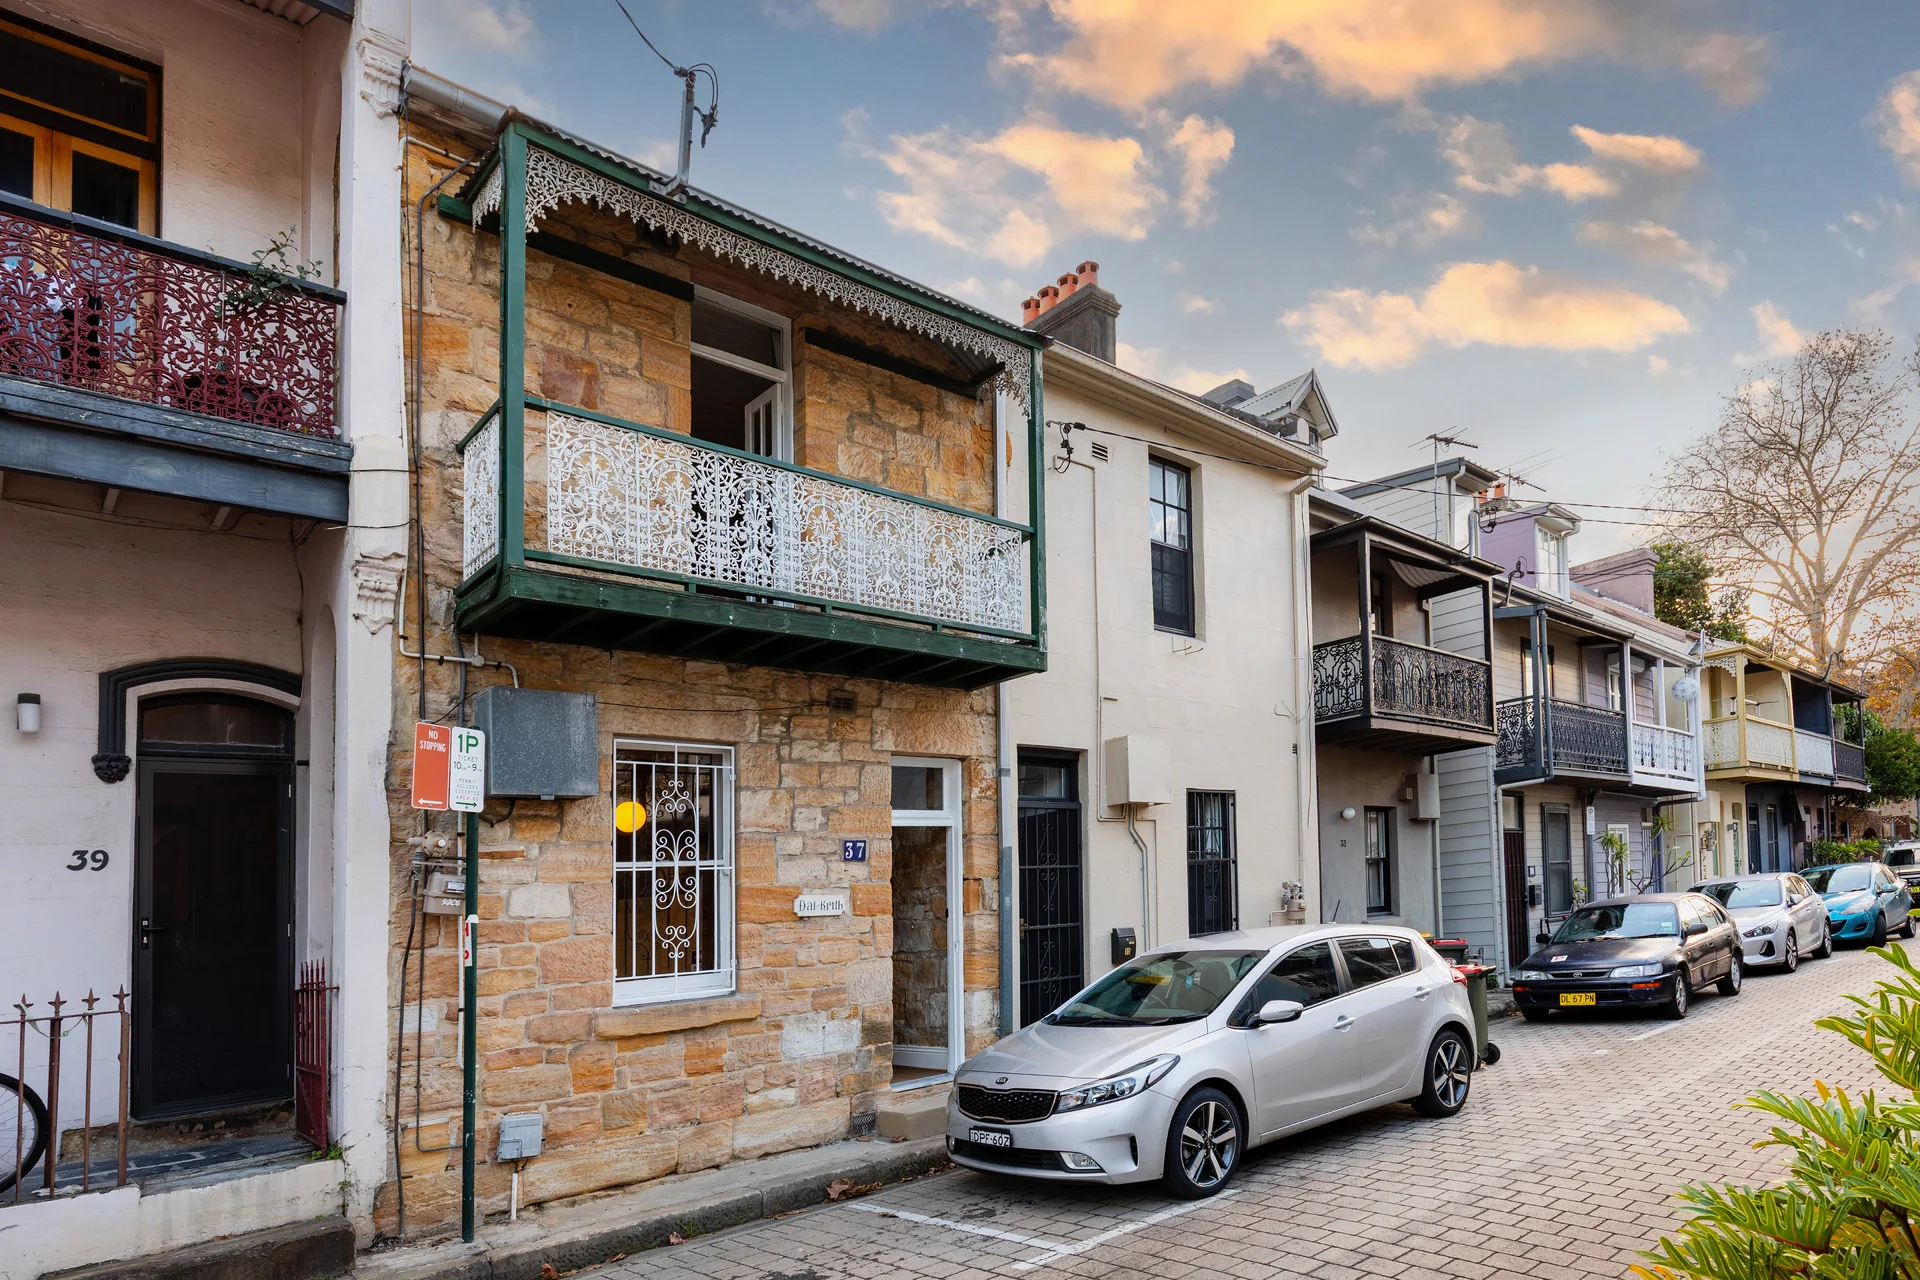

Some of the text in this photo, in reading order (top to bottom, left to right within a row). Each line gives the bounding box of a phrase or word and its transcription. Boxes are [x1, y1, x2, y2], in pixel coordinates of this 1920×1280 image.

[428, 729, 439, 740] NO
[419, 740, 446, 753] STOPPING
[457, 733, 479, 754] 1P
[458, 755, 478, 763] TICKET
[1340, 839, 1346, 847] 33
[844, 842, 865, 859] 37
[66, 849, 110, 872] 39
[1572, 994, 1583, 1003] 67
